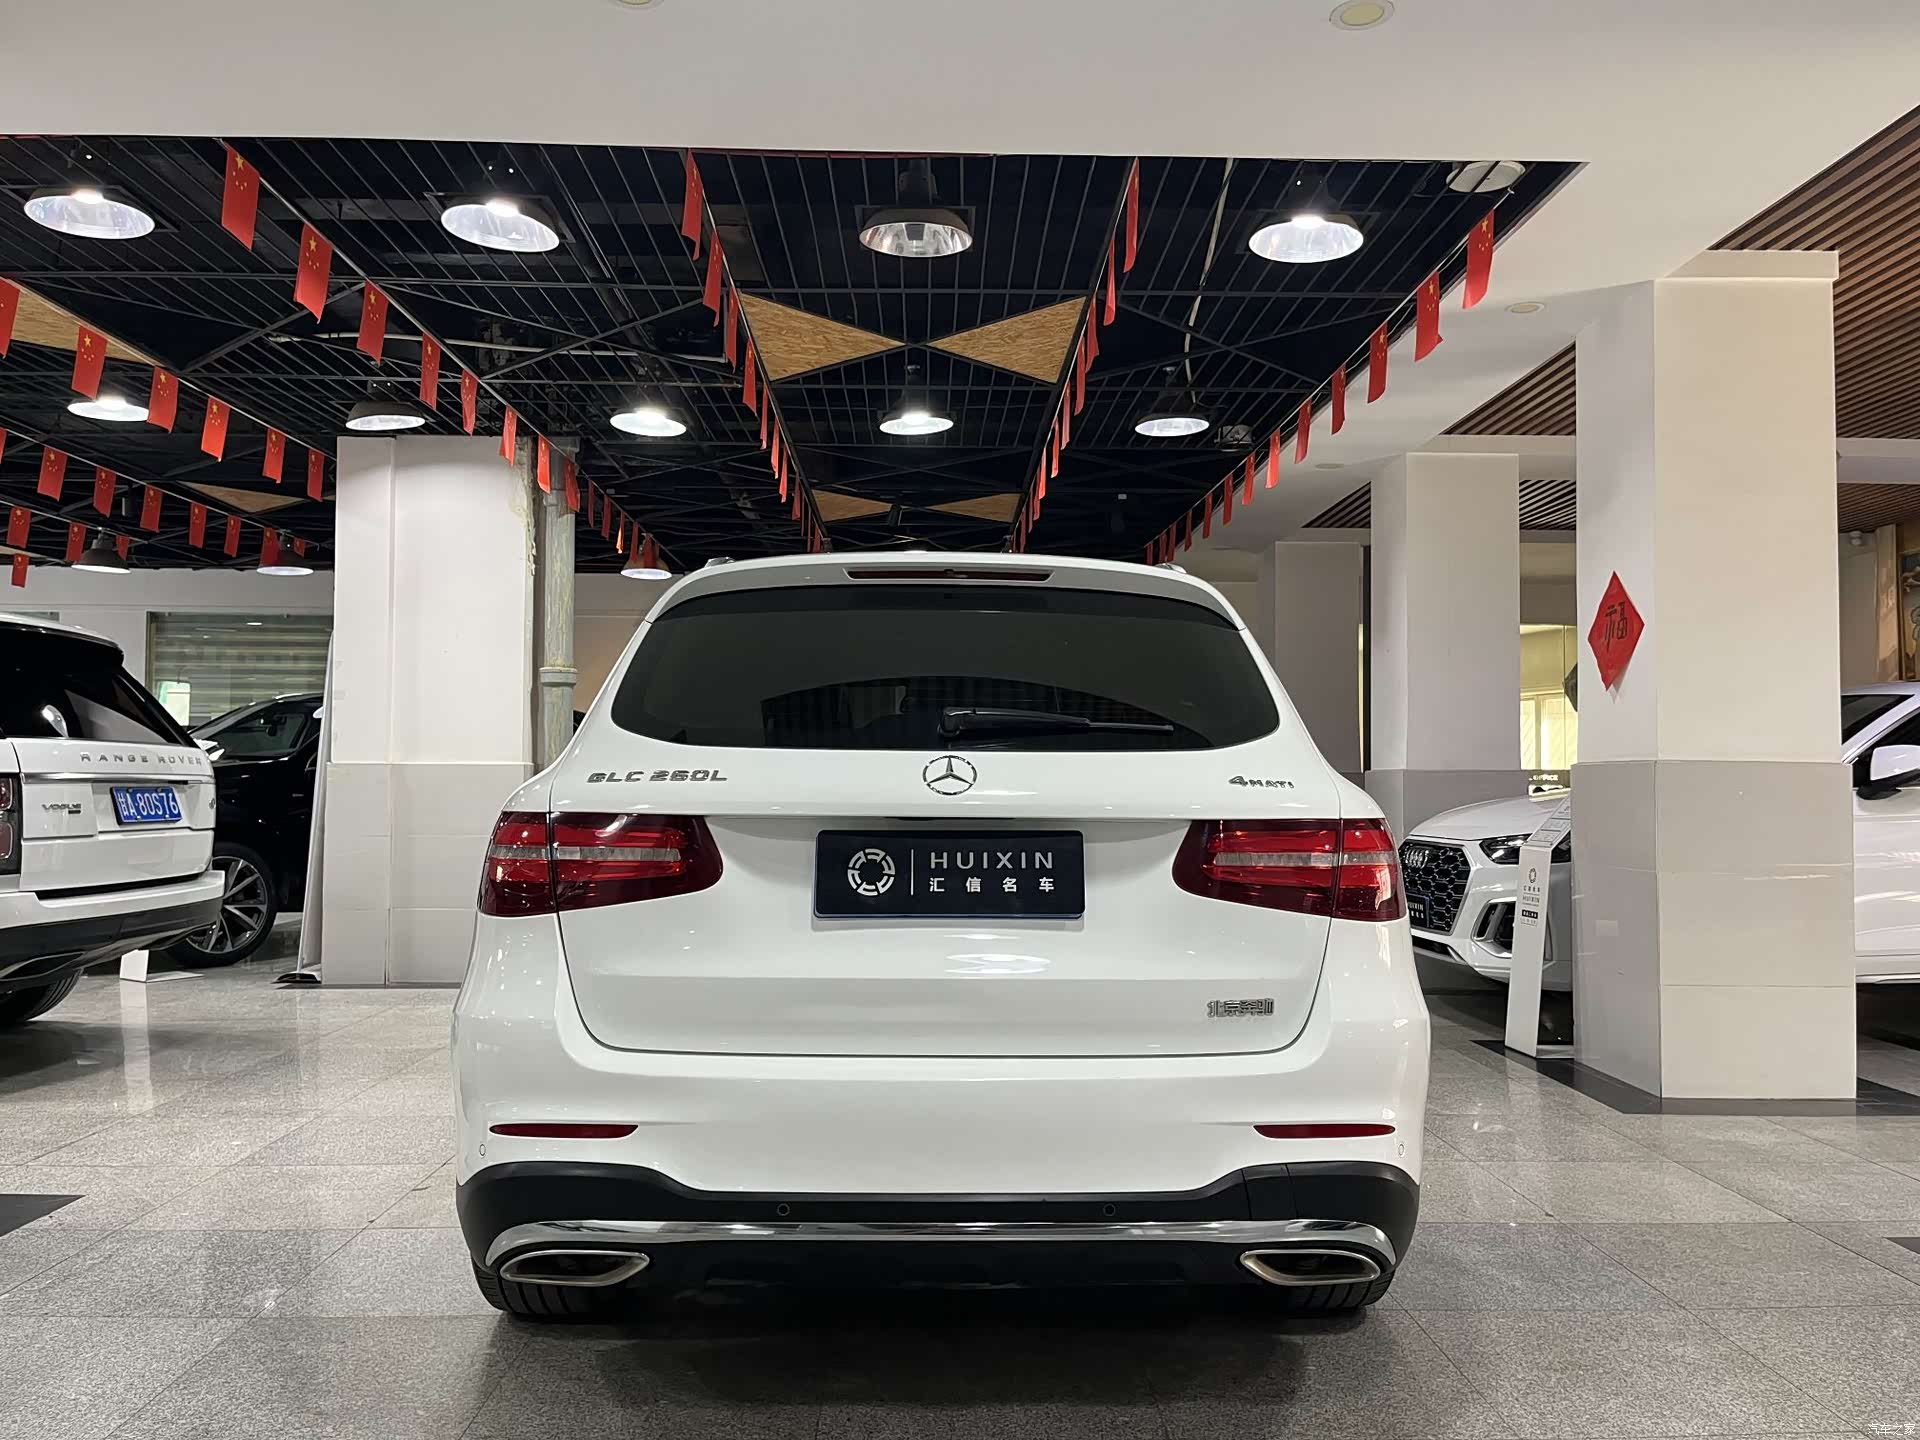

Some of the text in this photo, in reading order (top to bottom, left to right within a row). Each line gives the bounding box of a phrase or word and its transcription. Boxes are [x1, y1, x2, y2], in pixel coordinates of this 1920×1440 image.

[80, 754, 202, 766] RANGE ROVER
[587, 769, 727, 783] GLC 260L
[930, 852, 1053, 869] HUIXIN
[929, 877, 1055, 893] 汇信名车
